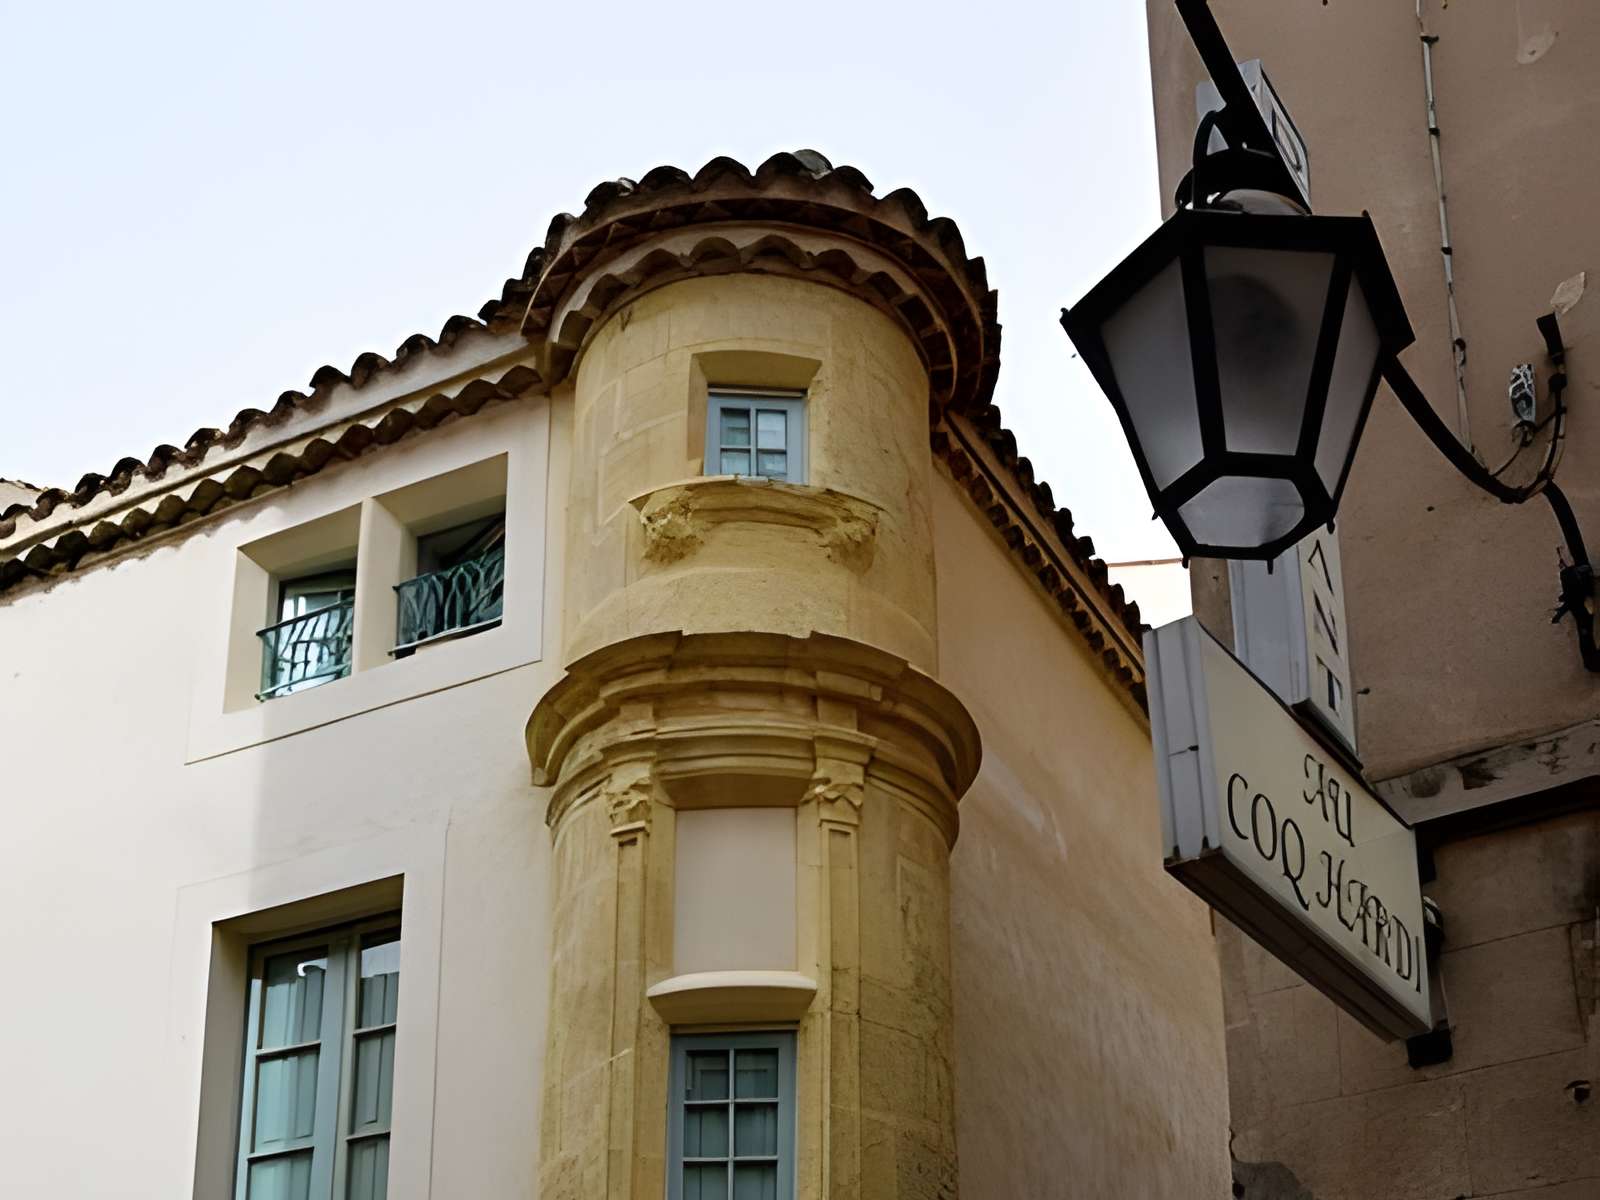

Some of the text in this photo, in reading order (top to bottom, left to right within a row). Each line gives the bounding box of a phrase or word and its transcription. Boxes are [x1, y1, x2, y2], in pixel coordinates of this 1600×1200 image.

[1303, 753, 1355, 848] AU
[1227, 773, 1421, 993] COQ HARDI
